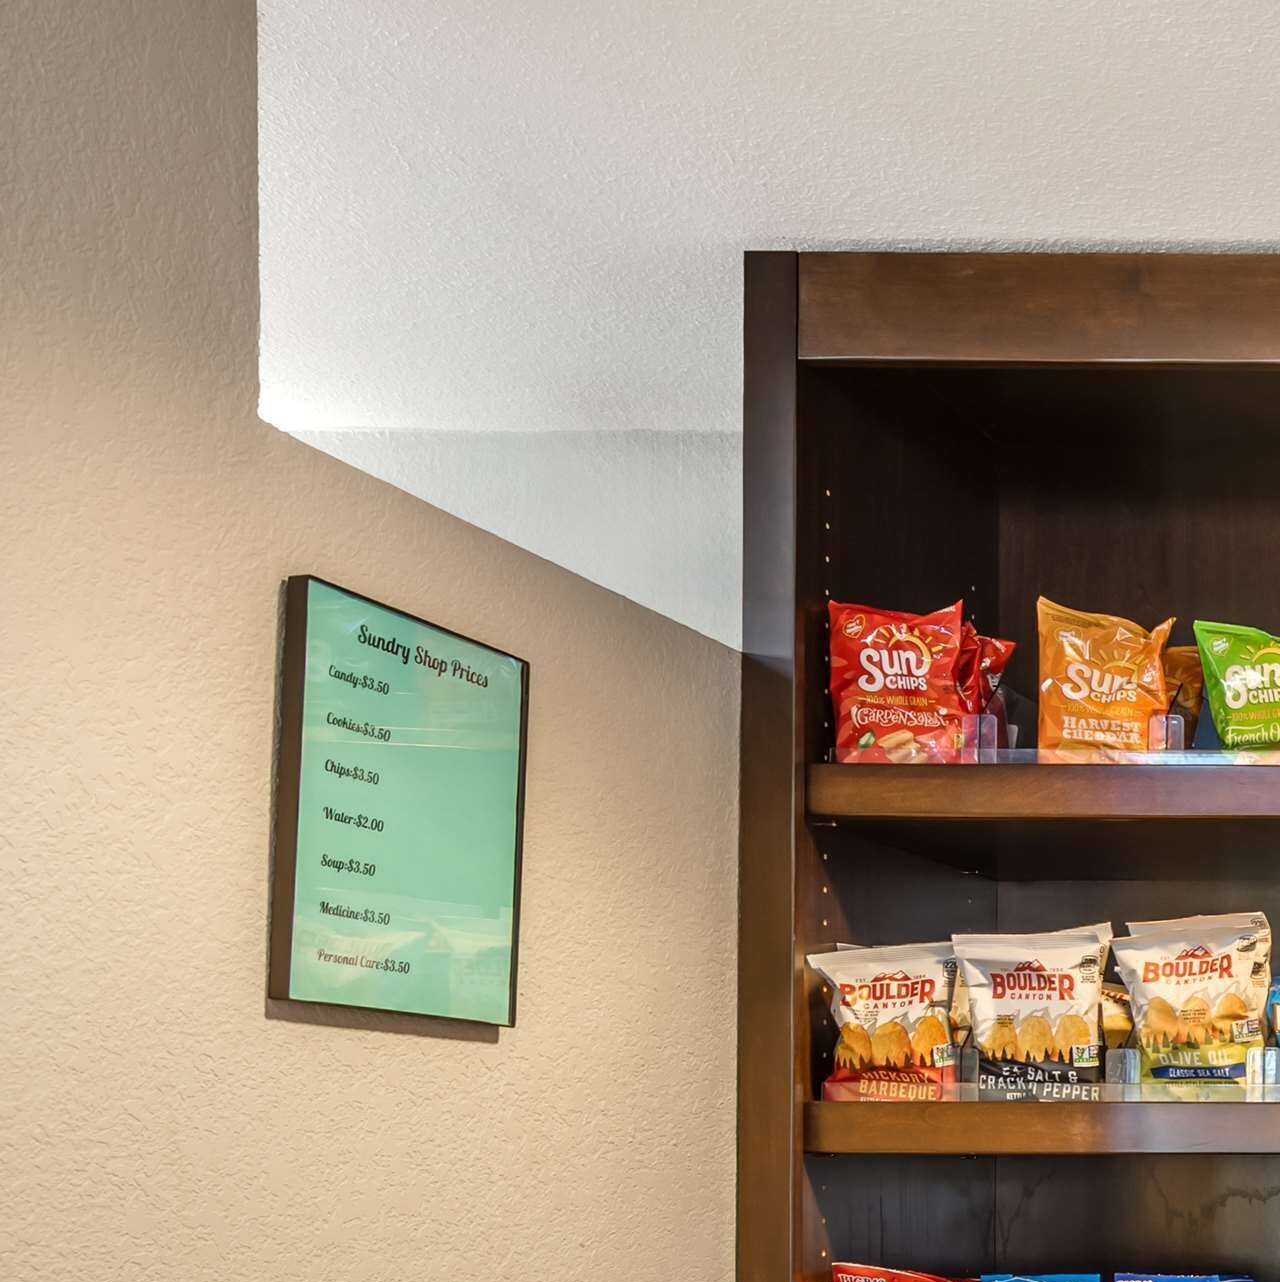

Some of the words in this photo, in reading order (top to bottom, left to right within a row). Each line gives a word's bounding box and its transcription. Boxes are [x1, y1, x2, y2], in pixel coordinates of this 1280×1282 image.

[357, 624, 411, 664] Sundry
[414, 646, 448, 677] Shop
[450, 660, 489, 688] Prices
[328, 665, 390, 695] Candy:$3.50
[858, 647, 931, 692] Sun
[886, 675, 928, 690] CHIPS
[1090, 689, 1137, 704] CHIPS
[326, 711, 391, 743] Cookies:$3.50
[1063, 716, 1141, 730] HARVEST
[1062, 729, 1141, 743] CHEDDAR
[1225, 724, 1269, 747] French
[324, 758, 380, 785] Chips:$3.50
[322, 806, 384, 833] Water:$2.00
[320, 854, 376, 877] Soup:$3.50
[319, 900, 391, 927] Medicine:$3.50
[317, 948, 358, 967] Personal
[1143, 954, 1234, 983] BOULDER
[839, 978, 936, 1006] BOULDER
[991, 973, 1075, 1000] BOULDER
[864, 1001, 913, 1010] CANYON
[1159, 1051, 1200, 1065] OLIVE
[1208, 1050, 1232, 1064] OIL
[862, 1070, 929, 1083] HICKORY
[1027, 1067, 1061, 1082] SALT
[1169, 1068, 1196, 1078] CLASSIC
[1213, 1067, 1231, 1077] SALT
[859, 1080, 937, 1100] BARBEQUE
[1043, 1082, 1100, 1101] PEPPER
